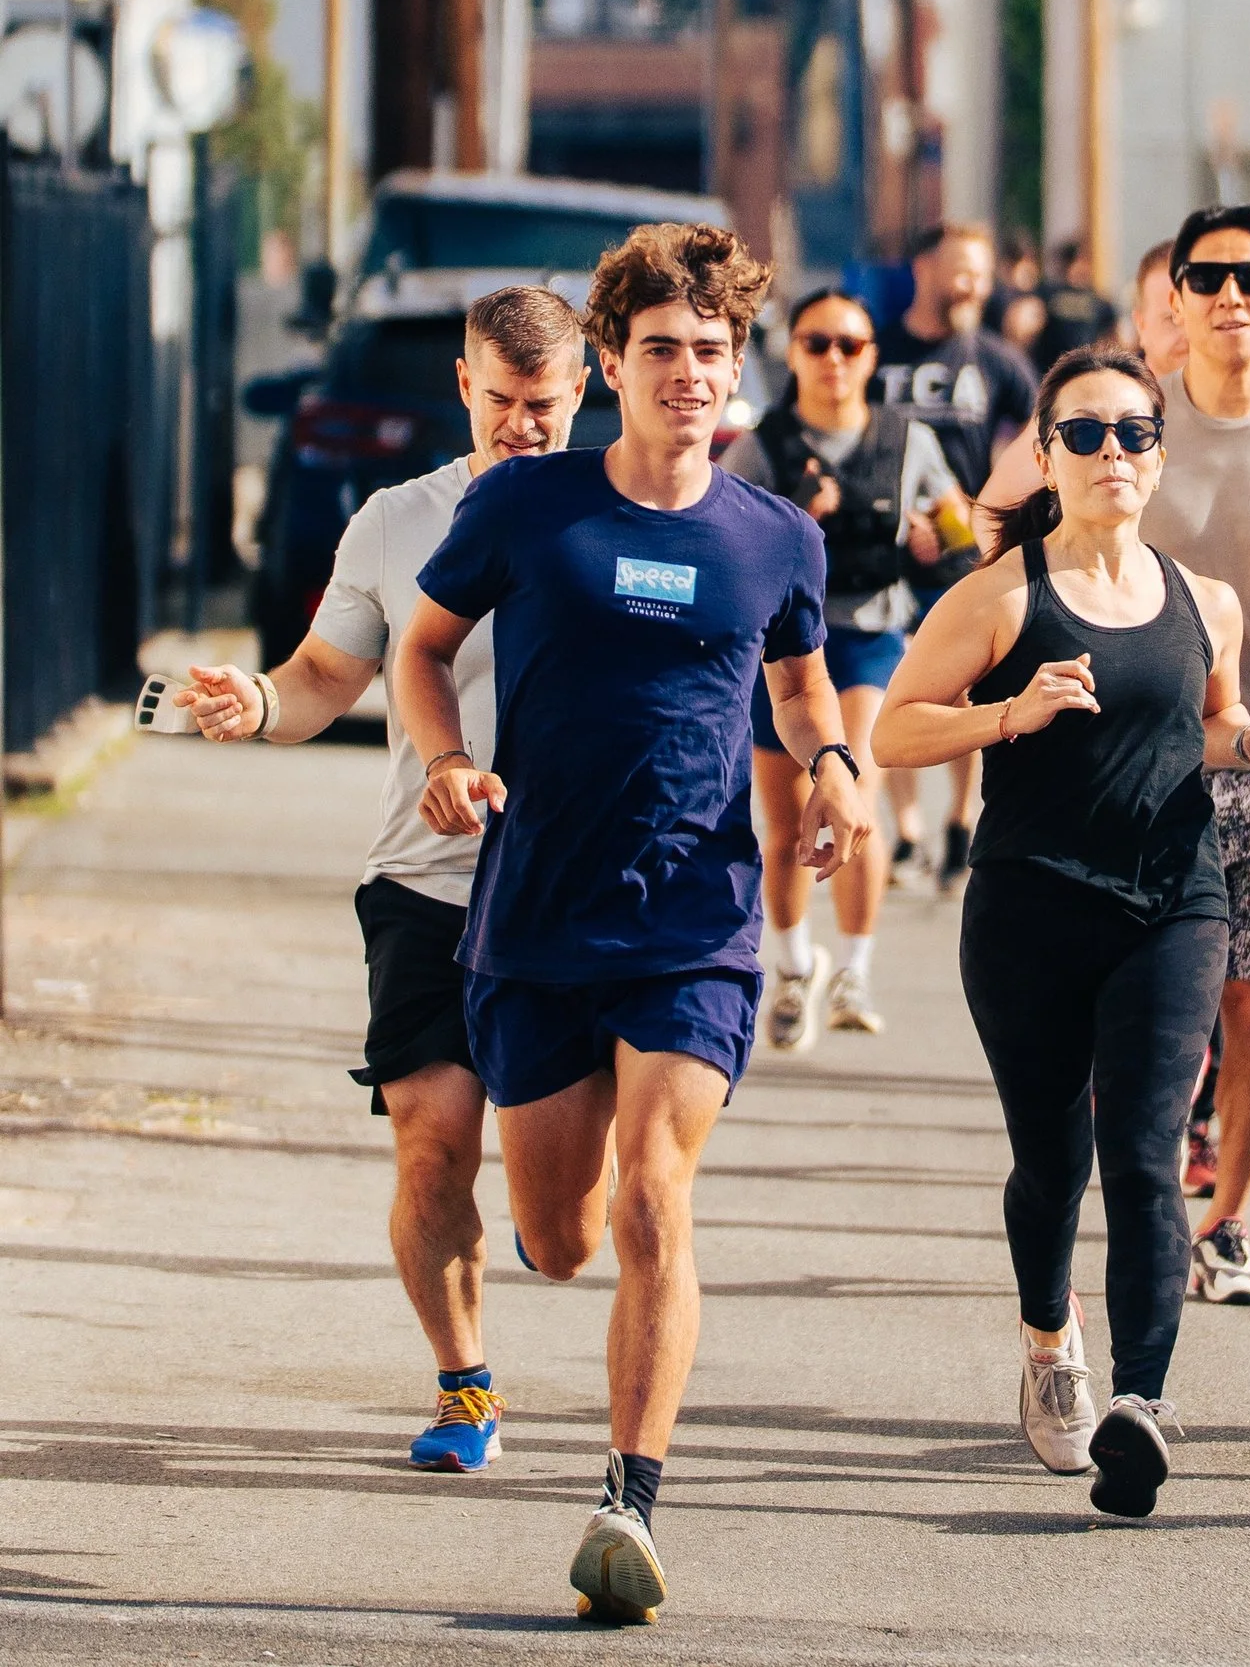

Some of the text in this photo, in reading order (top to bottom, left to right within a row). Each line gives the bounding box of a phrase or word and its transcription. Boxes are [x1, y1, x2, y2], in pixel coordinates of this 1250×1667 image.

[616, 561, 697, 591] Speed
[626, 599, 680, 613] RESISTANCE
[629, 607, 677, 620] ATHLETICS
